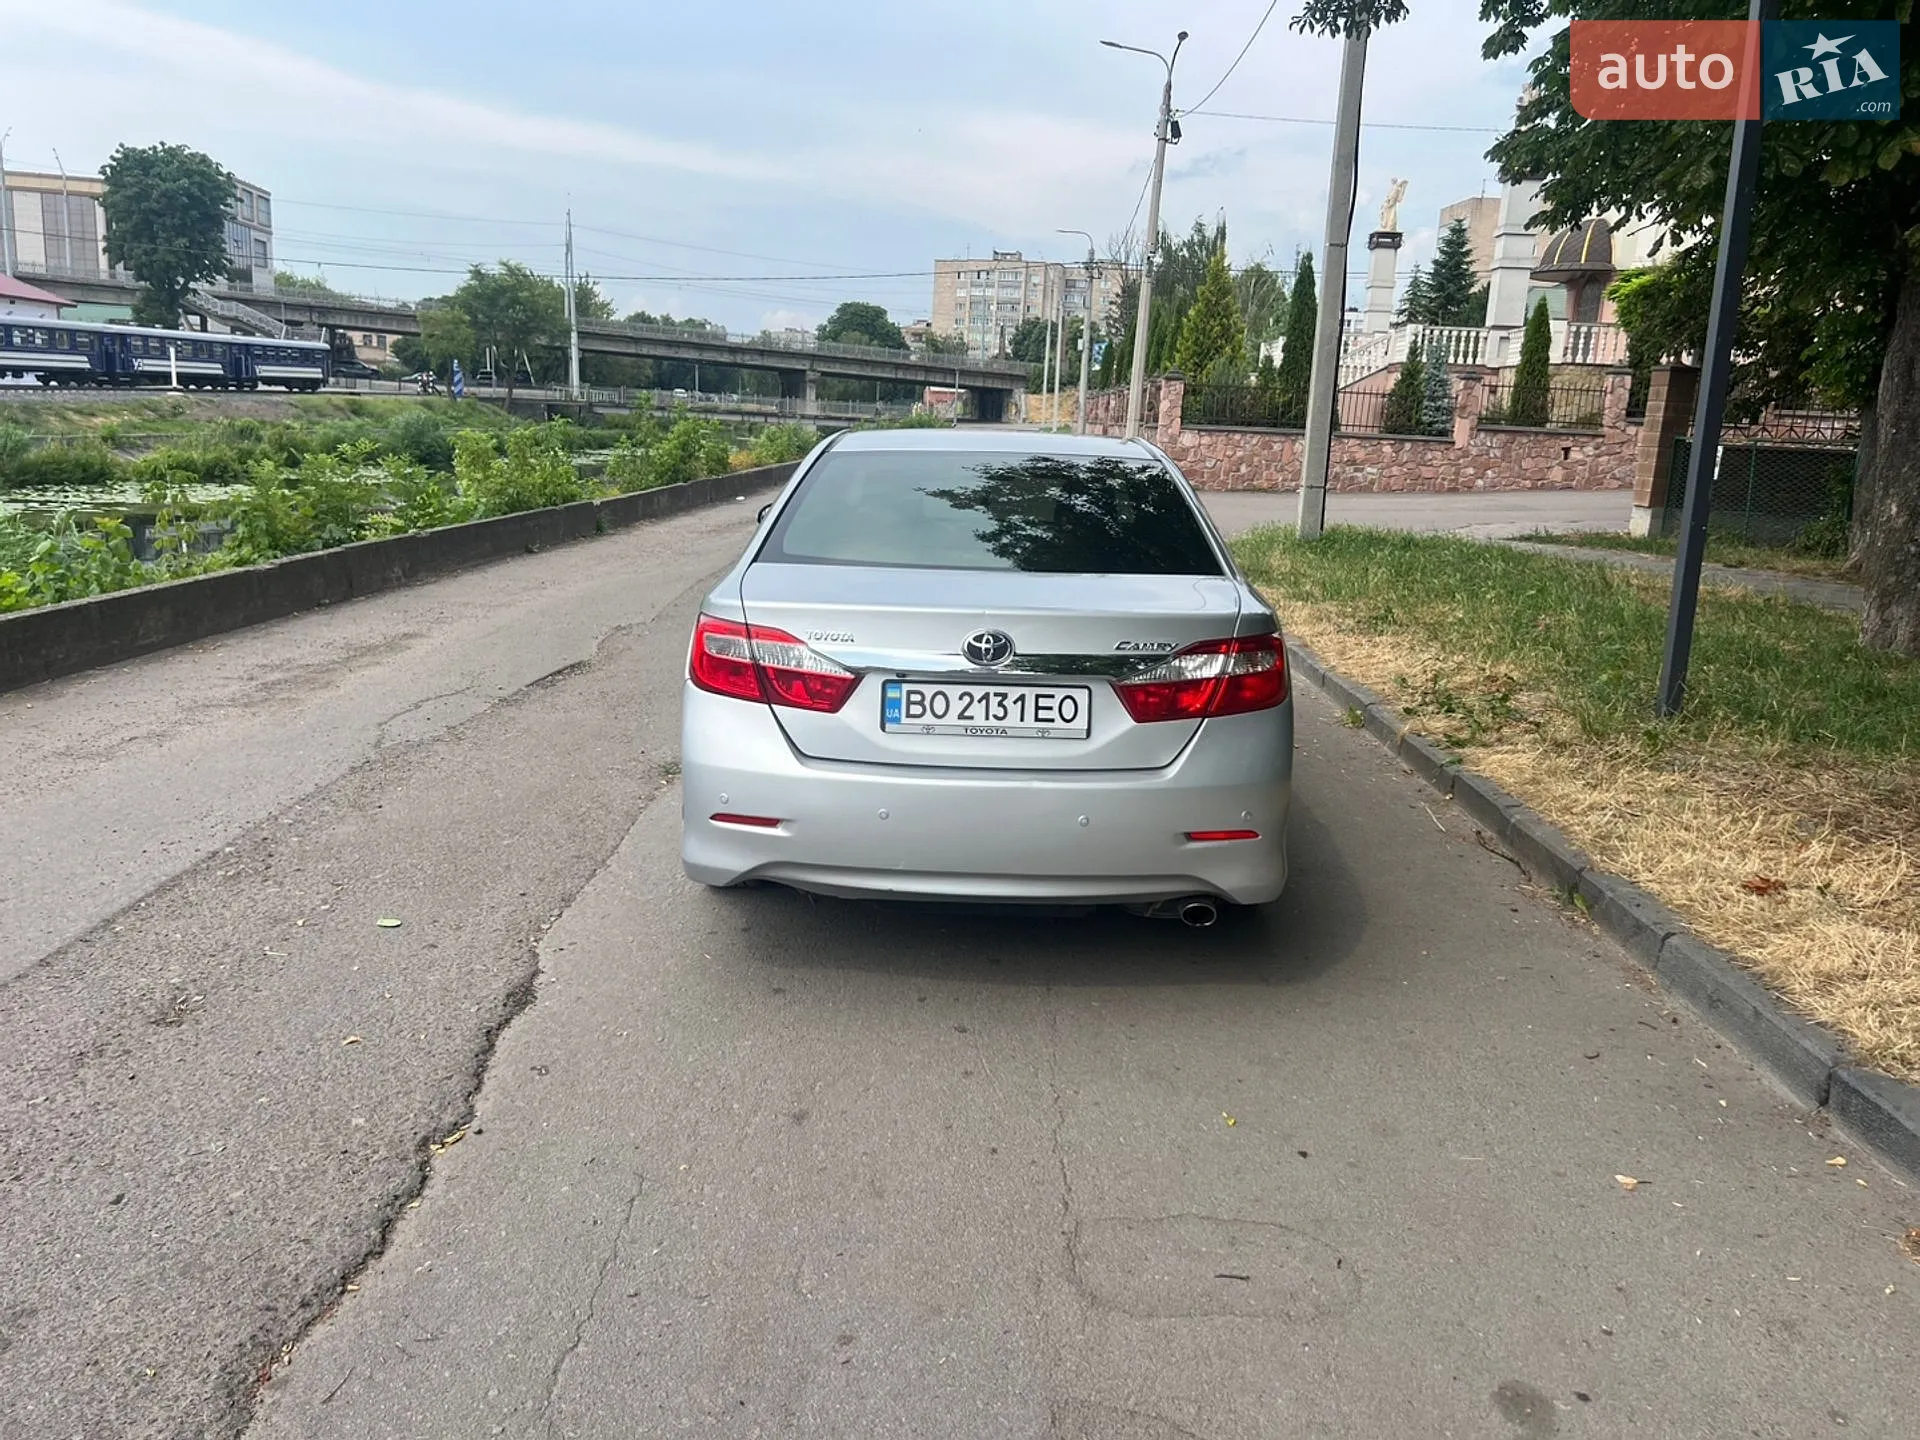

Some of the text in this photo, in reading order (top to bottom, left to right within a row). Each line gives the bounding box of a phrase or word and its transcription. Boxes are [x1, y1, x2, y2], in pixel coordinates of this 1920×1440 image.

[807, 631, 855, 643] TOYOTA
[1114, 641, 1179, 651] CAMRY
[905, 689, 1079, 724] BO 2131 EO
[964, 726, 1009, 736] TOYOTA
